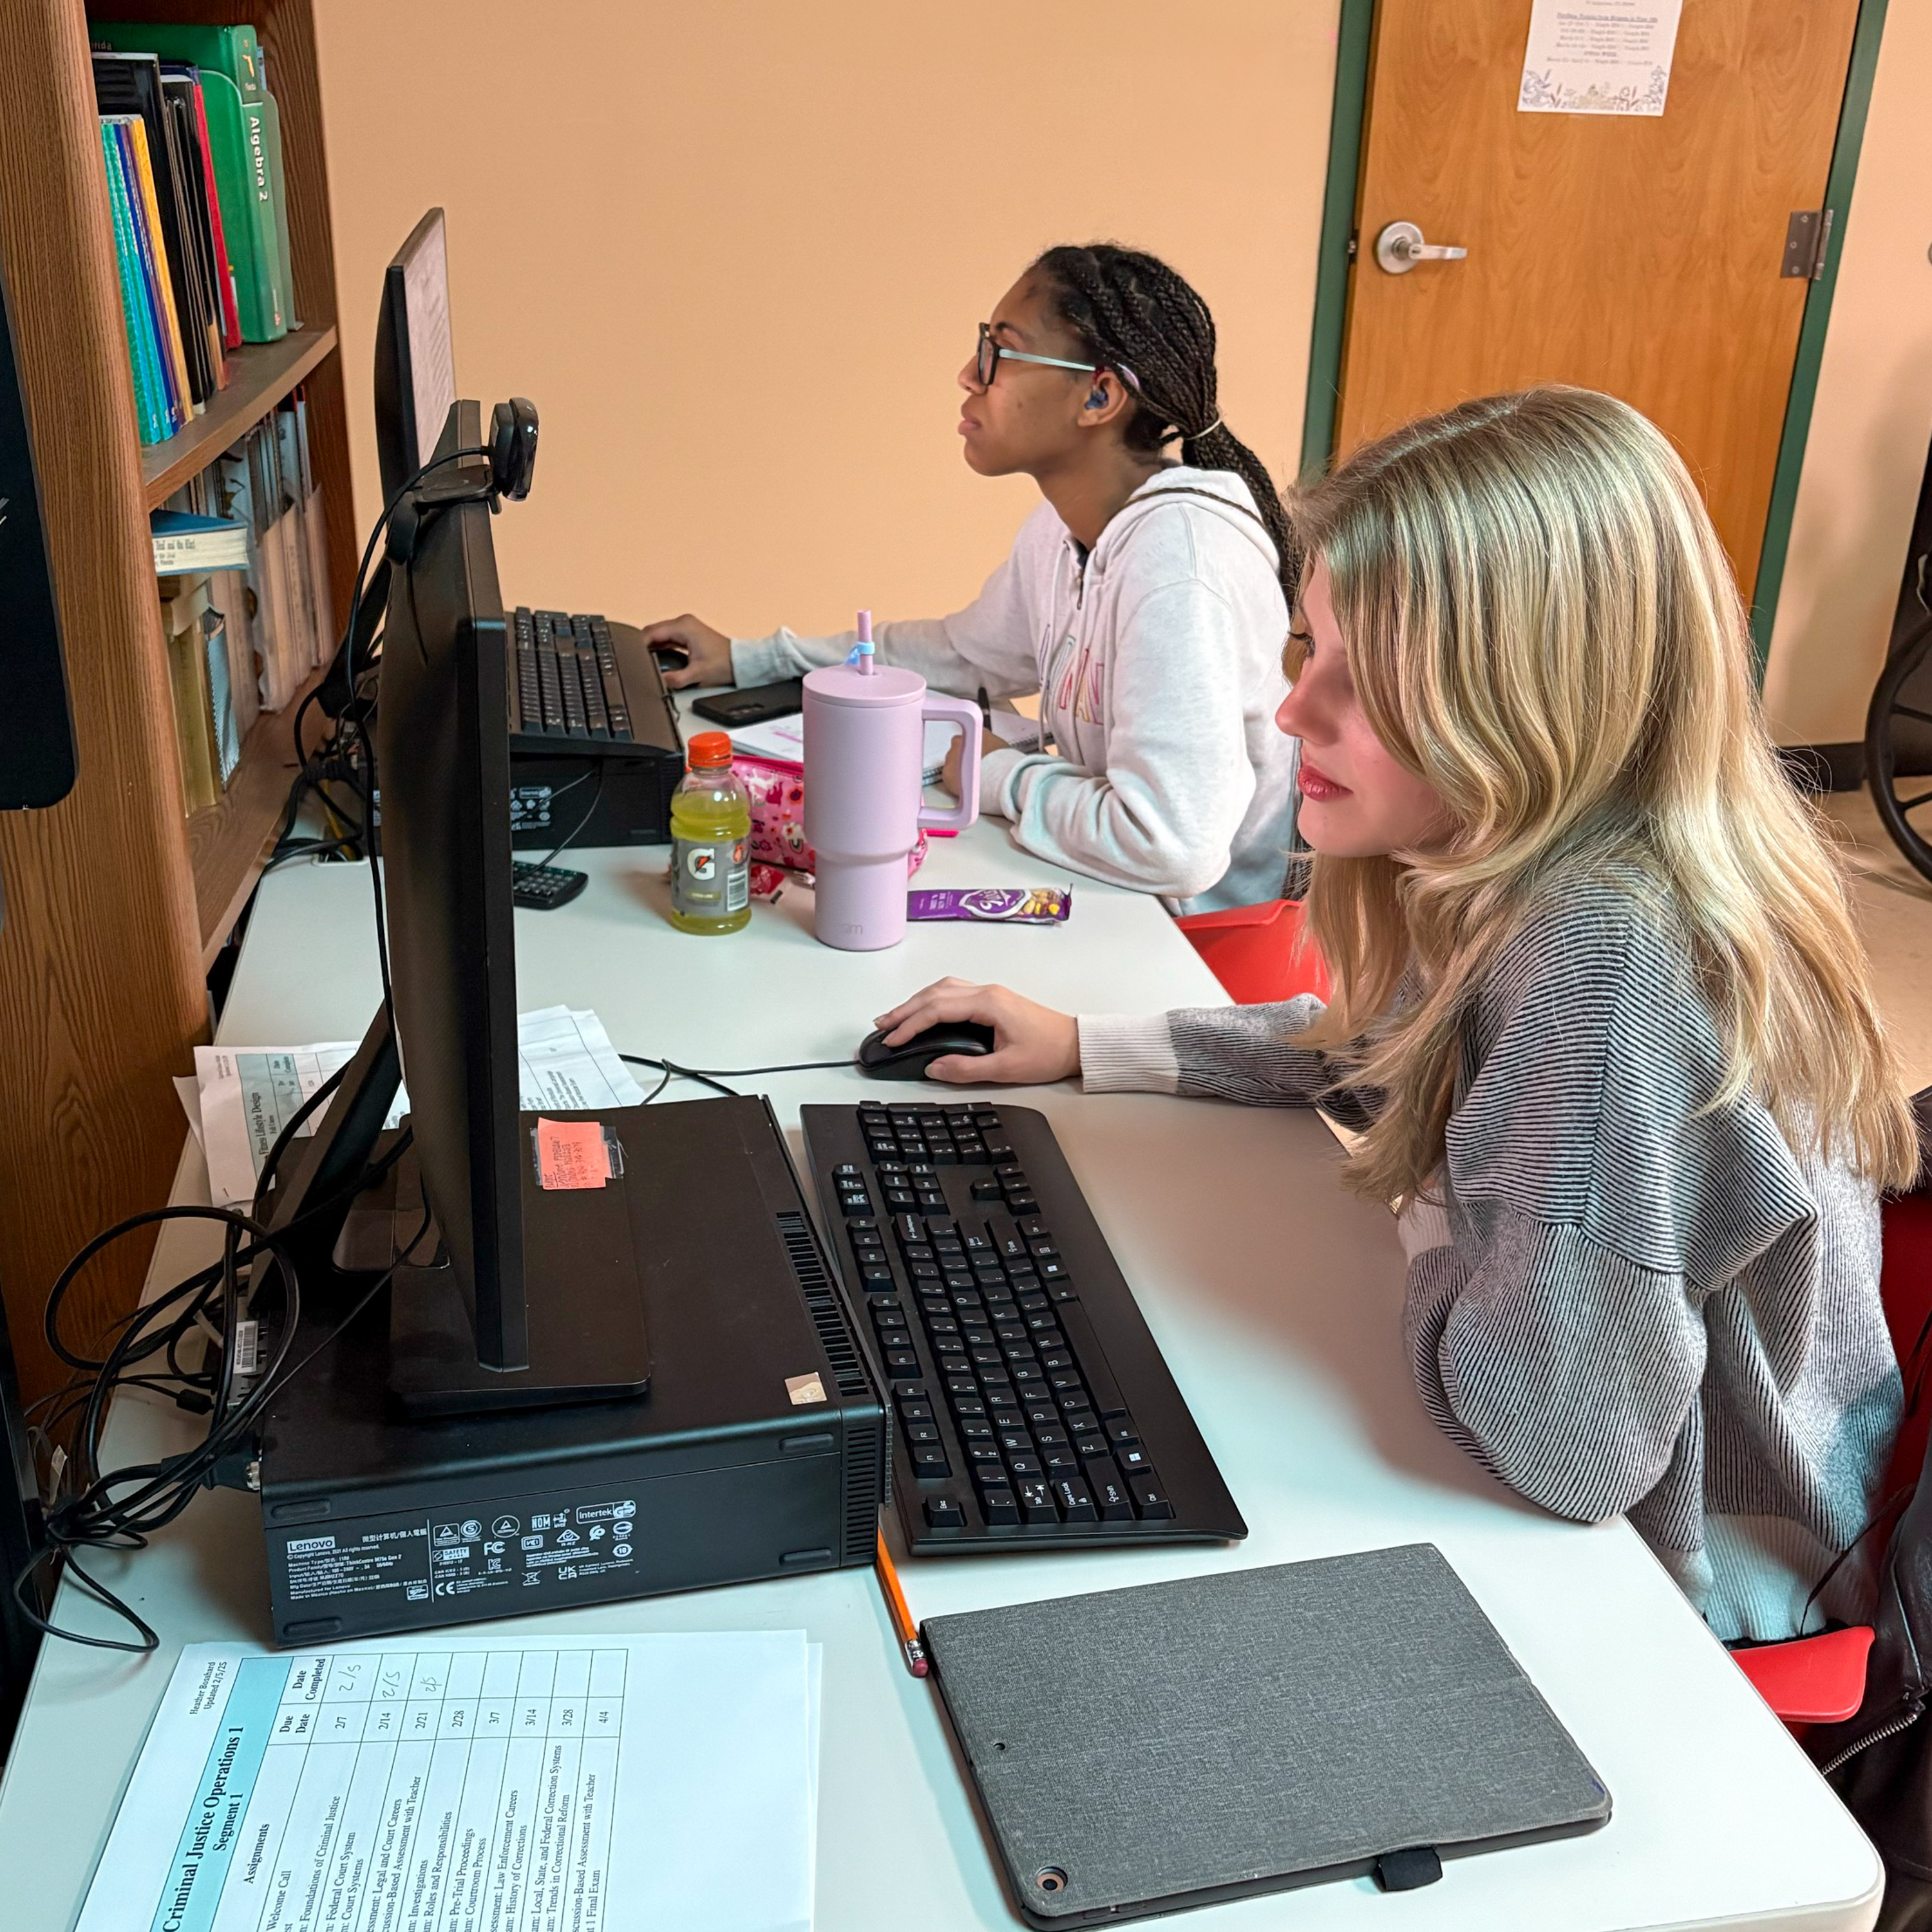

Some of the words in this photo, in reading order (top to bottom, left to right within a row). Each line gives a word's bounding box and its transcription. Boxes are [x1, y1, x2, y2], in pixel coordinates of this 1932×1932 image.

[249, 116, 265, 187] Algebra
[260, 191, 268, 202] 2
[687, 848, 715, 881] G
[251, 1092, 262, 1113] Design
[531, 1516, 551, 1529] NOM
[579, 1508, 612, 1519] Intertek
[612, 1501, 636, 1518] GS
[289, 1539, 334, 1552] Lenovo
[558, 1565, 576, 1574] UK
[558, 1571, 578, 1580] CA
[189, 1690, 205, 1714] Heather
[199, 1662, 216, 1690] Bosshard
[203, 1683, 219, 1710] Updated
[213, 1662, 227, 1683] 2/5/25
[292, 1669, 307, 1690] Date
[305, 1658, 326, 1701] Completed
[279, 1715, 294, 1734] Due
[295, 1713, 310, 1734] Date
[378, 1712, 392, 1730] 2/14
[415, 1712, 428, 1729] 2/21
[451, 1710, 465, 1728] 2/28
[525, 1709, 537, 1726] 3/14
[562, 1709, 574, 1727] 3/28
[598, 1711, 609, 1724] 4/4
[549, 1745, 562, 1774] Systems
[406, 1776, 421, 1806] Teacher
[544, 1775, 558, 1815] Correction
[583, 1774, 596, 1802] Teacher
[325, 1795, 341, 1822] Justice
[387, 1798, 402, 1827] Careers
[404, 1806, 415, 1823] with
[505, 1790, 518, 1819] Careers
[558, 1794, 570, 1823] Reform
[582, 1803, 593, 1821] with
[162, 1863, 199, 1932] Criminal
[185, 1812, 216, 1859] Justice
[203, 1736, 241, 1808] Operations
[213, 1802, 241, 1852] Segment
[316, 1823, 334, 1857] Criminal
[381, 1829, 395, 1852] Court
[540, 1815, 553, 1844] Federal
[243, 1823, 270, 1884] Assignments
[340, 1832, 356, 1863] System
[393, 1824, 411, 1871] Assessment
[431, 1811, 452, 1873] Responsibilities
[456, 1828, 475, 1876] Proceedings
[473, 1837, 487, 1868] Process
[497, 1819, 514, 1870] Enforcement
[512, 1824, 527, 1870] Corrections
[539, 1846, 549, 1861] and
[551, 1824, 566, 1873] Correctional
[577, 1822, 591, 1868] Assessment
[314, 1858, 325, 1868] of
[380, 1853, 389, 1868] and
[535, 1862, 548, 1886] State,
[334, 1866, 348, 1886] Court
[347, 1858, 364, 1893] Systems
[372, 1870, 387, 1894] Legal
[408, 1859, 428, 1918] Investigations
[431, 1875, 440, 1890] and
[494, 1871, 506, 1890] Law
[511, 1871, 521, 1881] of
[550, 1875, 560, 1884] in
[589, 1870, 600, 1893] Exam
[266, 1889, 287, 1931] Welcome
[278, 1870, 292, 1888] Call
[299, 1870, 322, 1922] Foundations
[326, 1888, 342, 1921] Federal
[423, 1891, 437, 1917] Roles
[450, 1878, 465, 1915] Pre-Trial
[465, 1870, 482, 1915] Courtroom
[506, 1882, 522, 1915] History
[531, 1888, 545, 1914] Local,
[546, 1885, 559, 1914] Trends
[341, 1895, 355, 1920] Court
[586, 1896, 598, 1917] Final
